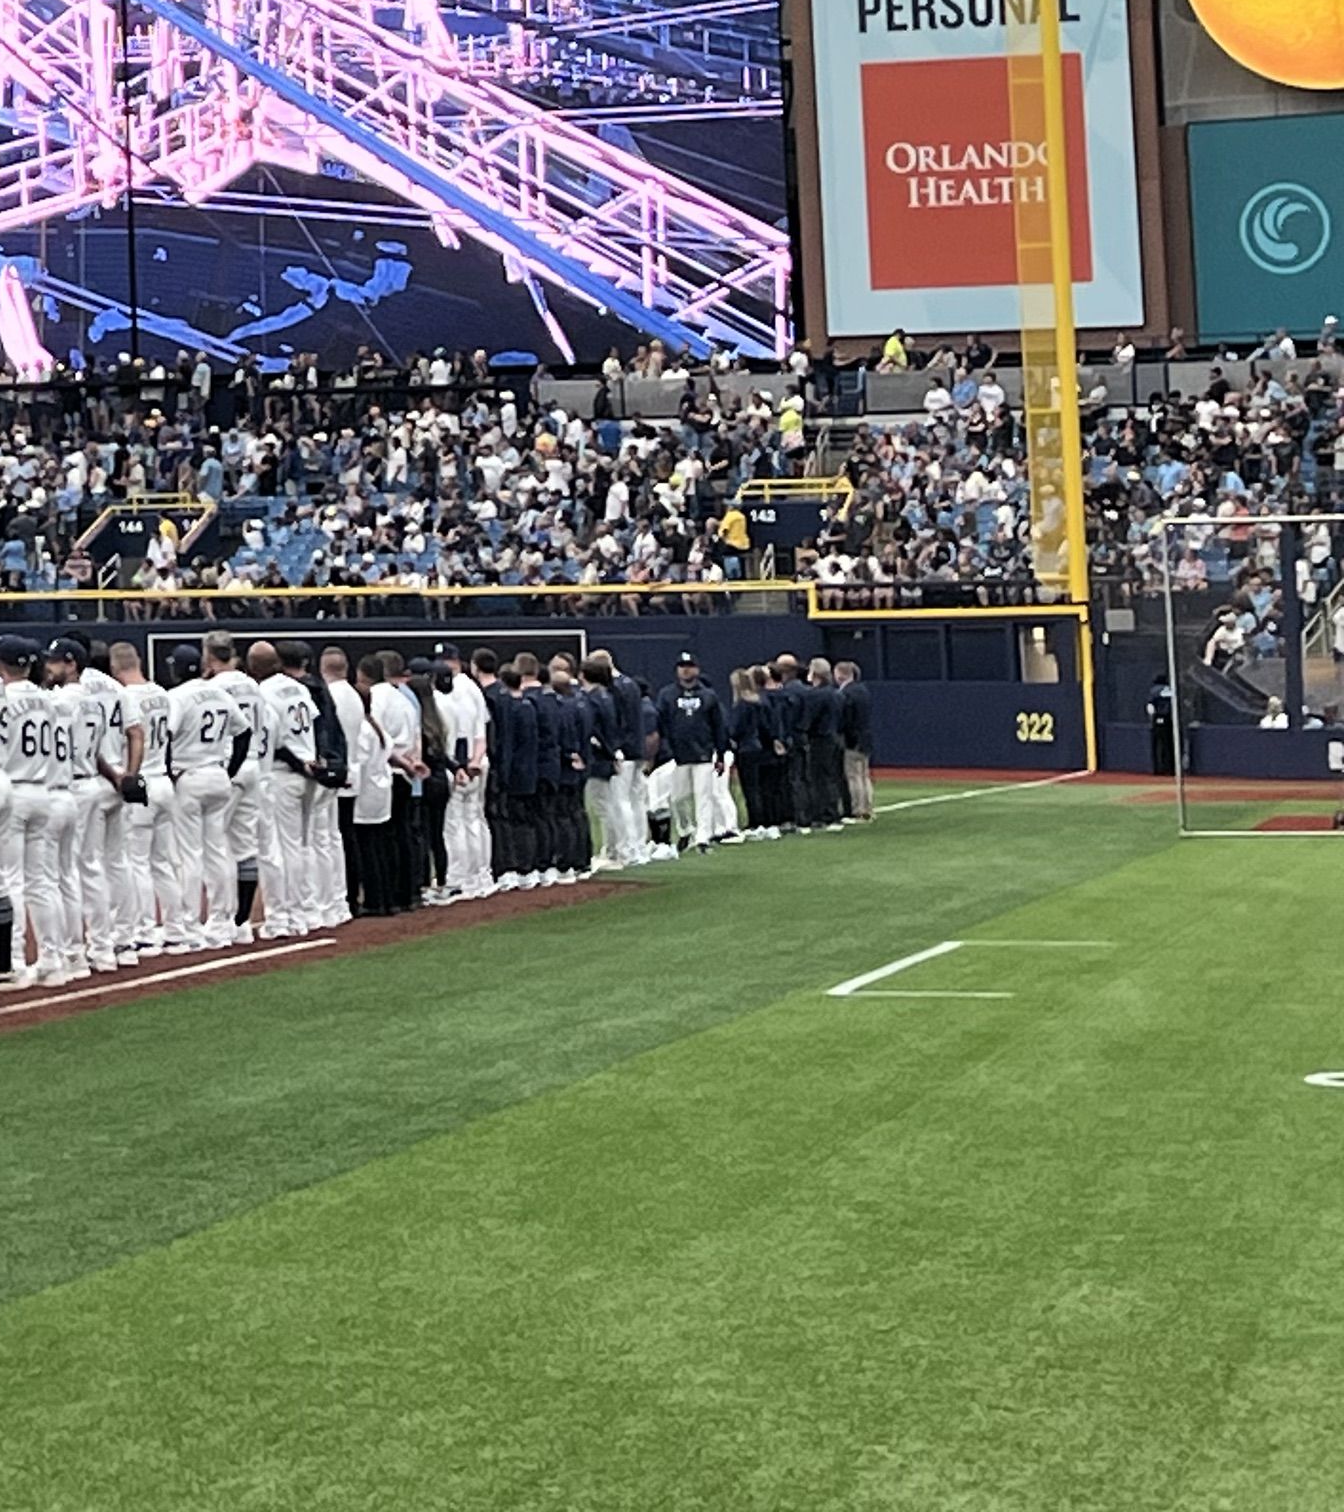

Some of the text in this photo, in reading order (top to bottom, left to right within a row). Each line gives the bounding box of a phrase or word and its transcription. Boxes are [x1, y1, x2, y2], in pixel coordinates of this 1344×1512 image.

[906, 175, 1047, 208] HEALTH
[199, 708, 230, 744] 27
[1016, 711, 1055, 743] 322
